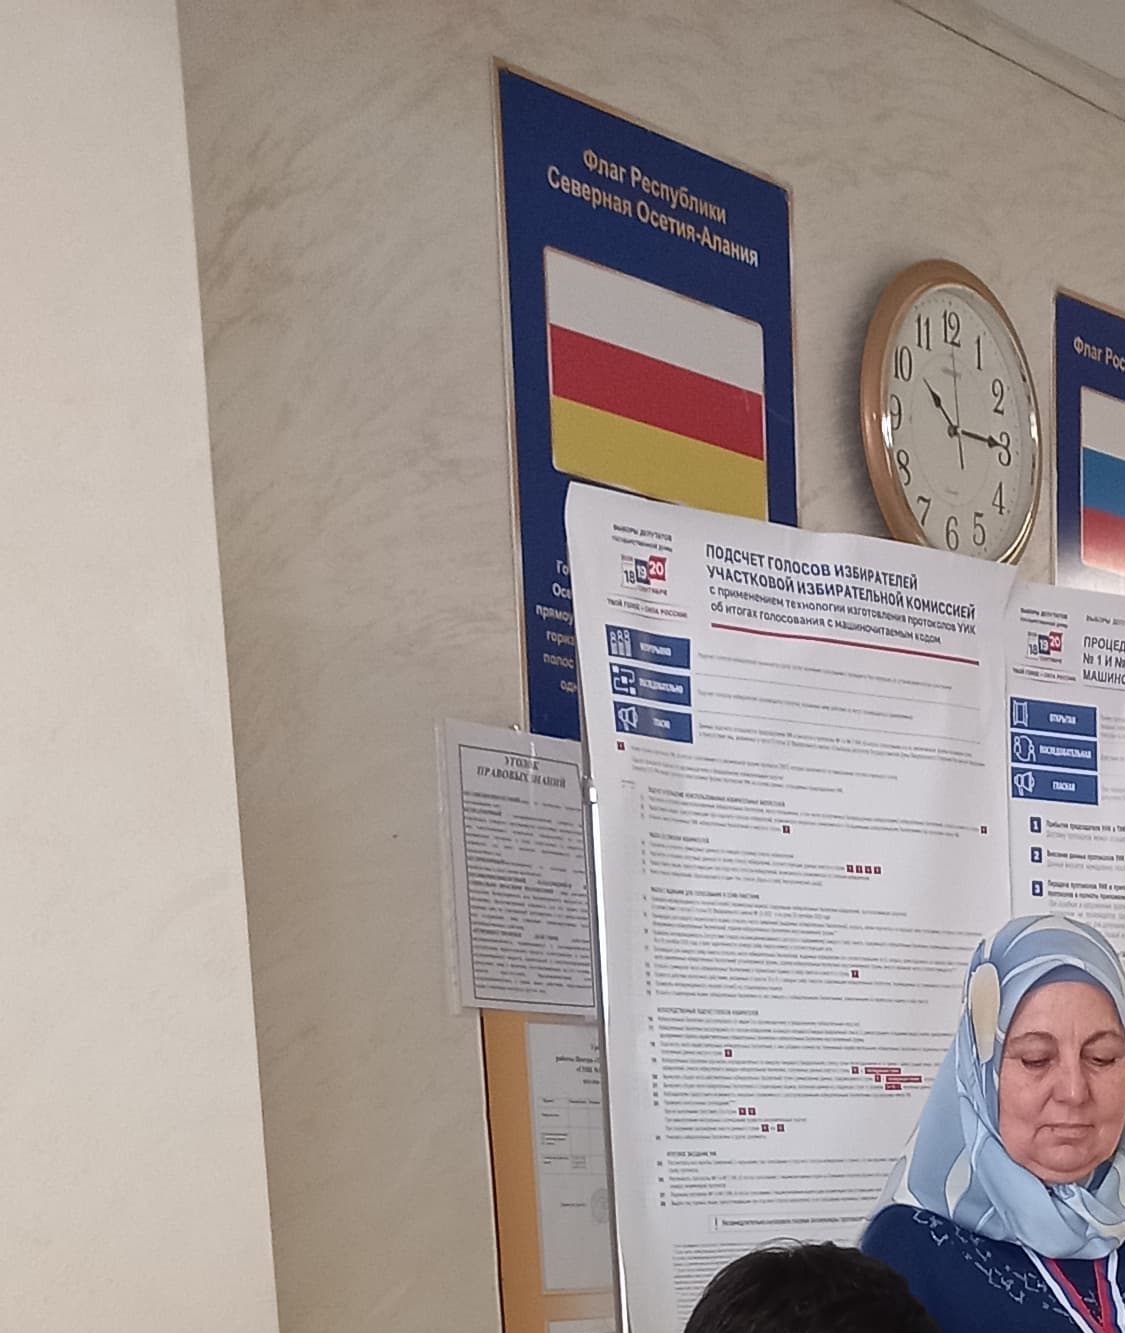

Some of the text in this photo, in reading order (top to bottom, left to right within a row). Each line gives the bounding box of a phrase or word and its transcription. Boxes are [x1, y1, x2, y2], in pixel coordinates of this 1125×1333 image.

[583, 149, 727, 225] Флаг Республики
[547, 165, 759, 268] Северная Осетия-Алания
[917, 313, 931, 351] 11
[943, 309, 961, 347] 12
[894, 345, 913, 382] 10
[975, 335, 984, 371] 1
[1073, 336, 1102, 361] Флаг
[890, 394, 902, 431] 9
[991, 378, 1005, 415] 2
[999, 431, 1012, 467] 3
[897, 449, 911, 486] 8
[917, 495, 931, 527] 7
[992, 481, 1005, 516] 4
[945, 516, 959, 550] 6
[973, 512, 986, 546] 5
[649, 561, 664, 575] 20
[705, 543, 918, 590] ПОДСЧЕТ ГОЛОСОВ ИЗБИРАТЕЛЕЙ
[706, 564, 976, 619] УЧАСТКОВОЙ ИЗБИРАТЕЛЬНОЙ КОМИССИЕЙ
[717, 587, 784, 608] применением
[785, 598, 846, 614] технологии
[710, 602, 723, 614] об
[725, 605, 757, 618] итогах
[759, 610, 825, 628] голосования
